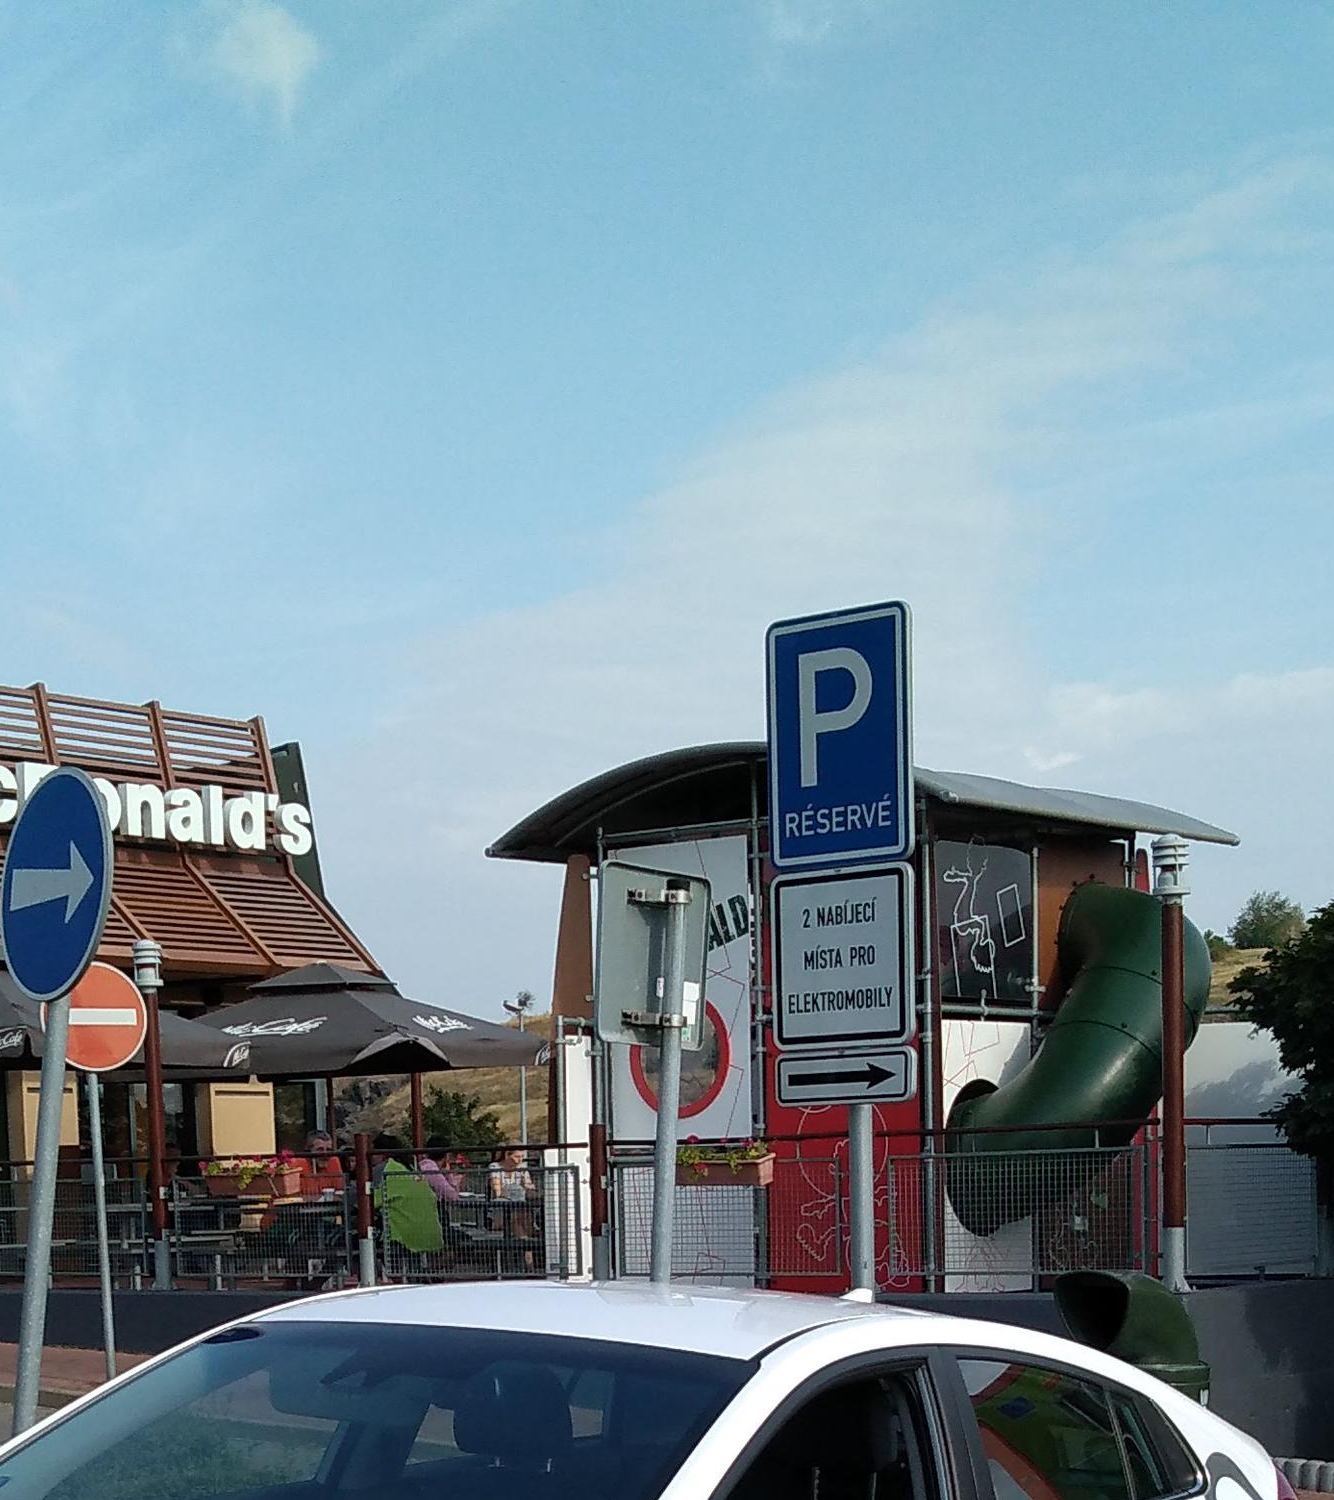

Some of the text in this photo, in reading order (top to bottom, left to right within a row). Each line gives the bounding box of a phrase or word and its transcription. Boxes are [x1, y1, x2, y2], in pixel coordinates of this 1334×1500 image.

[798, 647, 873, 788] P
[785, 793, 892, 838] RÉSERVÉ
[802, 897, 877, 929] 2 NABÍJECÍ
[804, 945, 876, 971] MÍSTA PRO
[788, 986, 893, 1014] ELEKTROMOBILY
